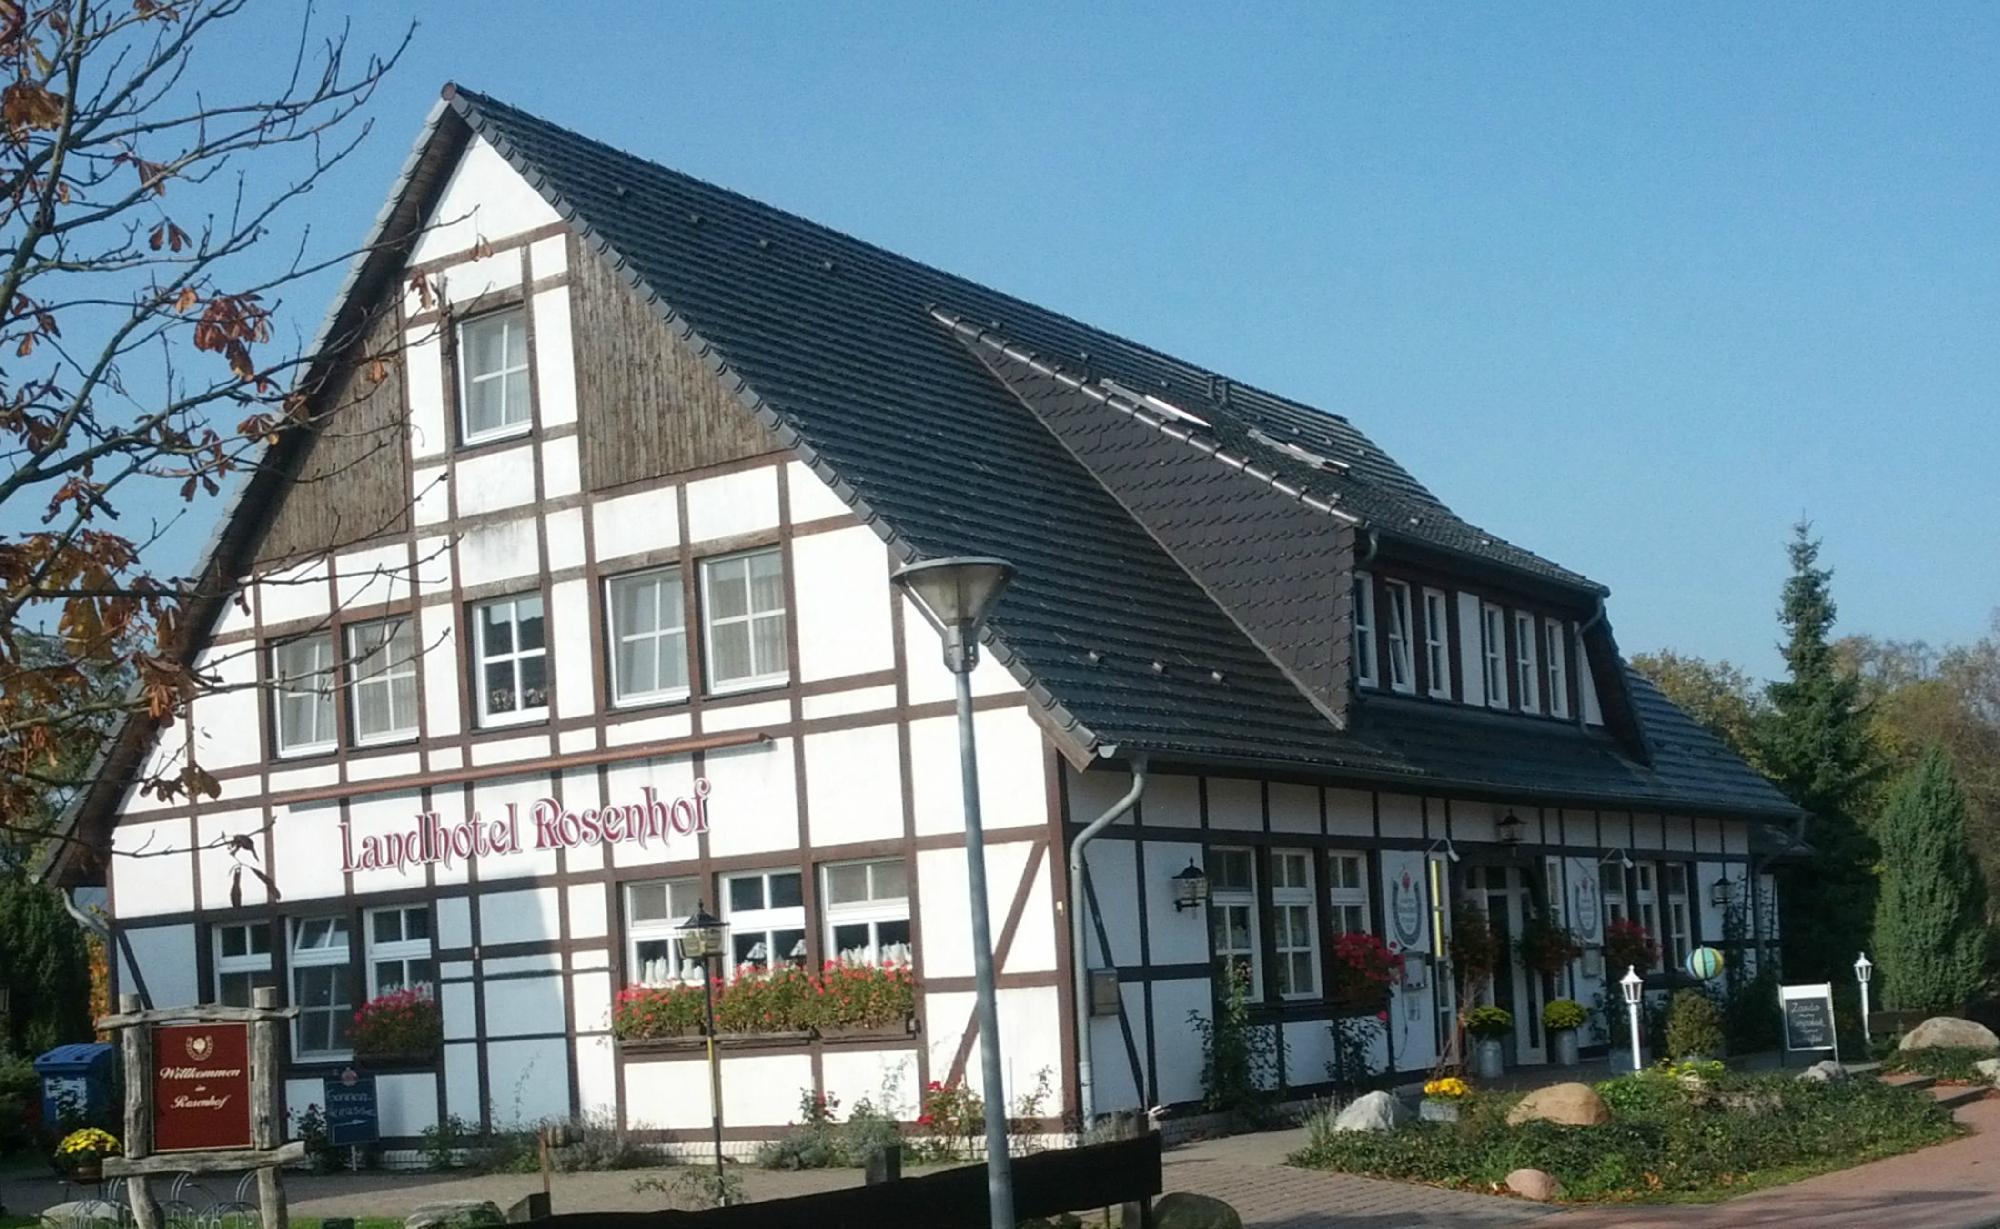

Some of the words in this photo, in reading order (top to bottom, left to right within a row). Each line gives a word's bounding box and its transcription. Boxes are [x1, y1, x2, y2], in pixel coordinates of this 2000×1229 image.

[339, 803, 521, 875] Landhotel
[531, 778, 712, 850] Rosenhof
[160, 1067, 241, 1080] Willkommen
[170, 1094, 232, 1110] Rosenhof
